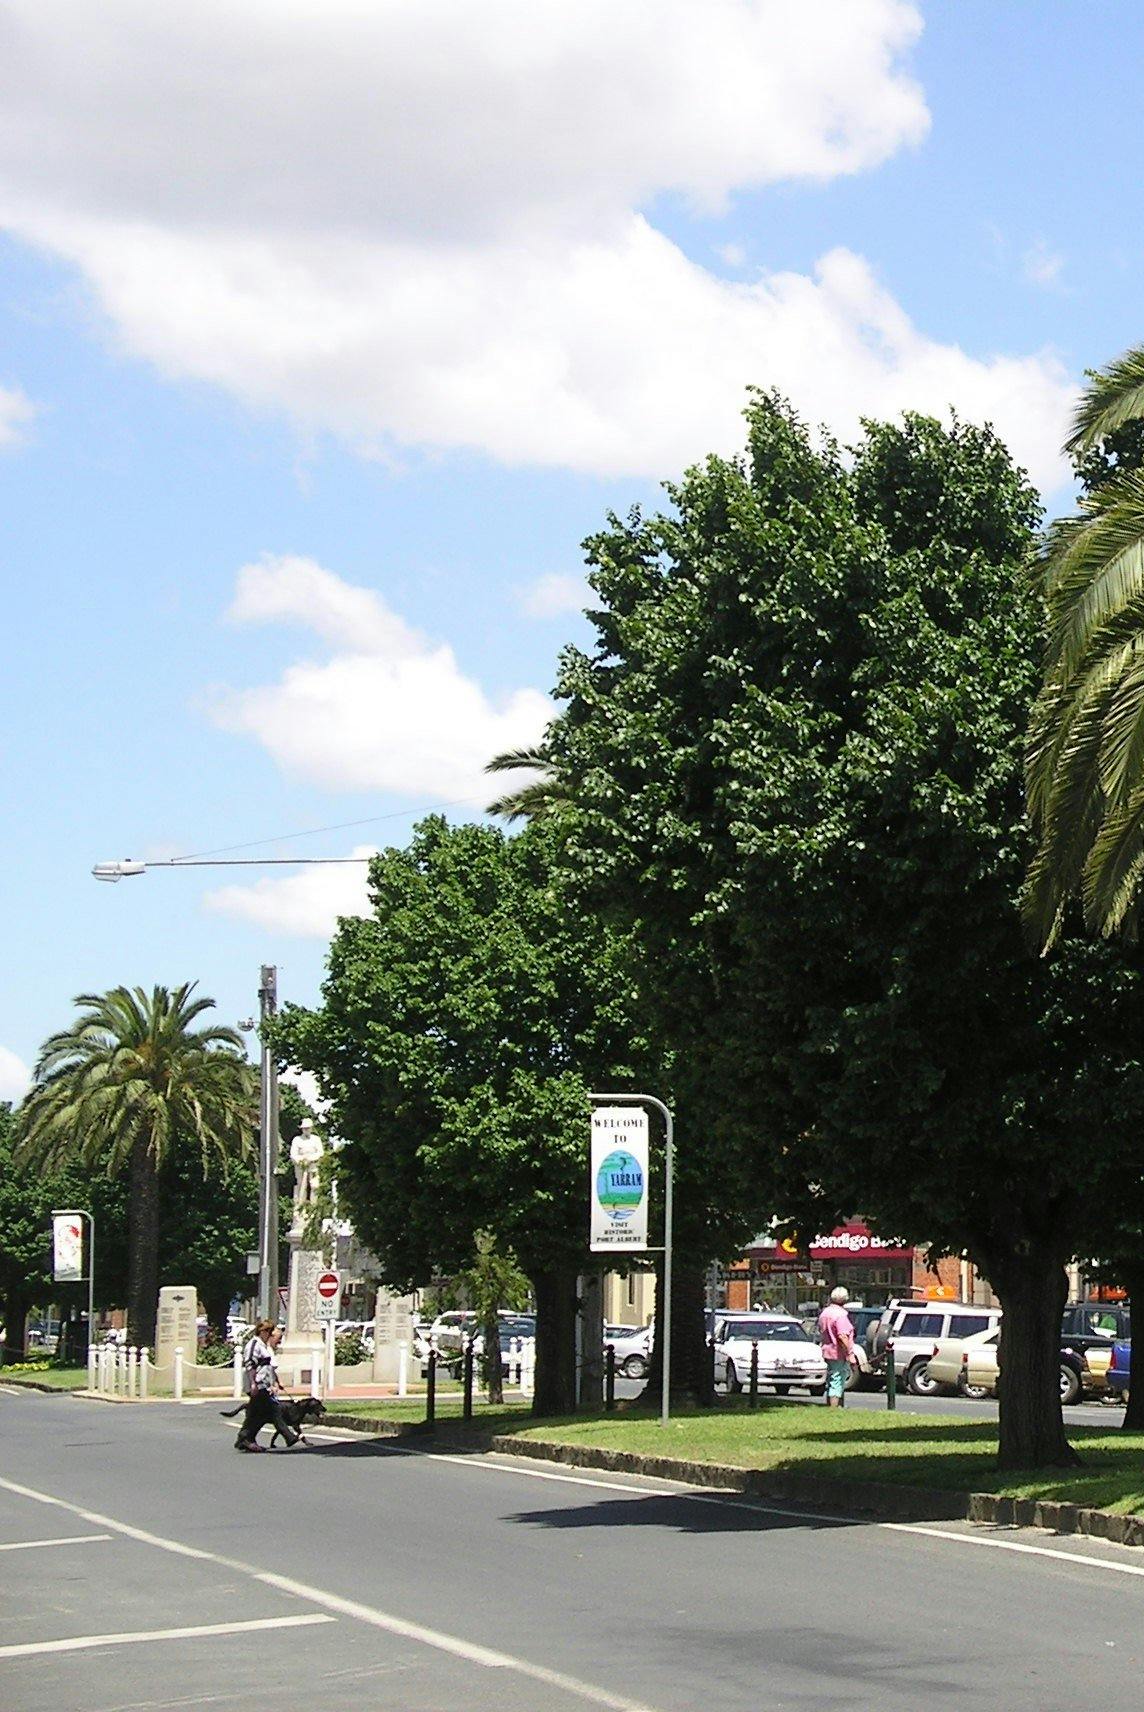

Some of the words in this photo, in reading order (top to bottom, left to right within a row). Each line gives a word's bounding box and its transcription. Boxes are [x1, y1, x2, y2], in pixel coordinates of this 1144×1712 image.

[594, 1118, 645, 1128] WELCOME
[614, 1134, 627, 1143] TO
[611, 1173, 642, 1187] YARRAM
